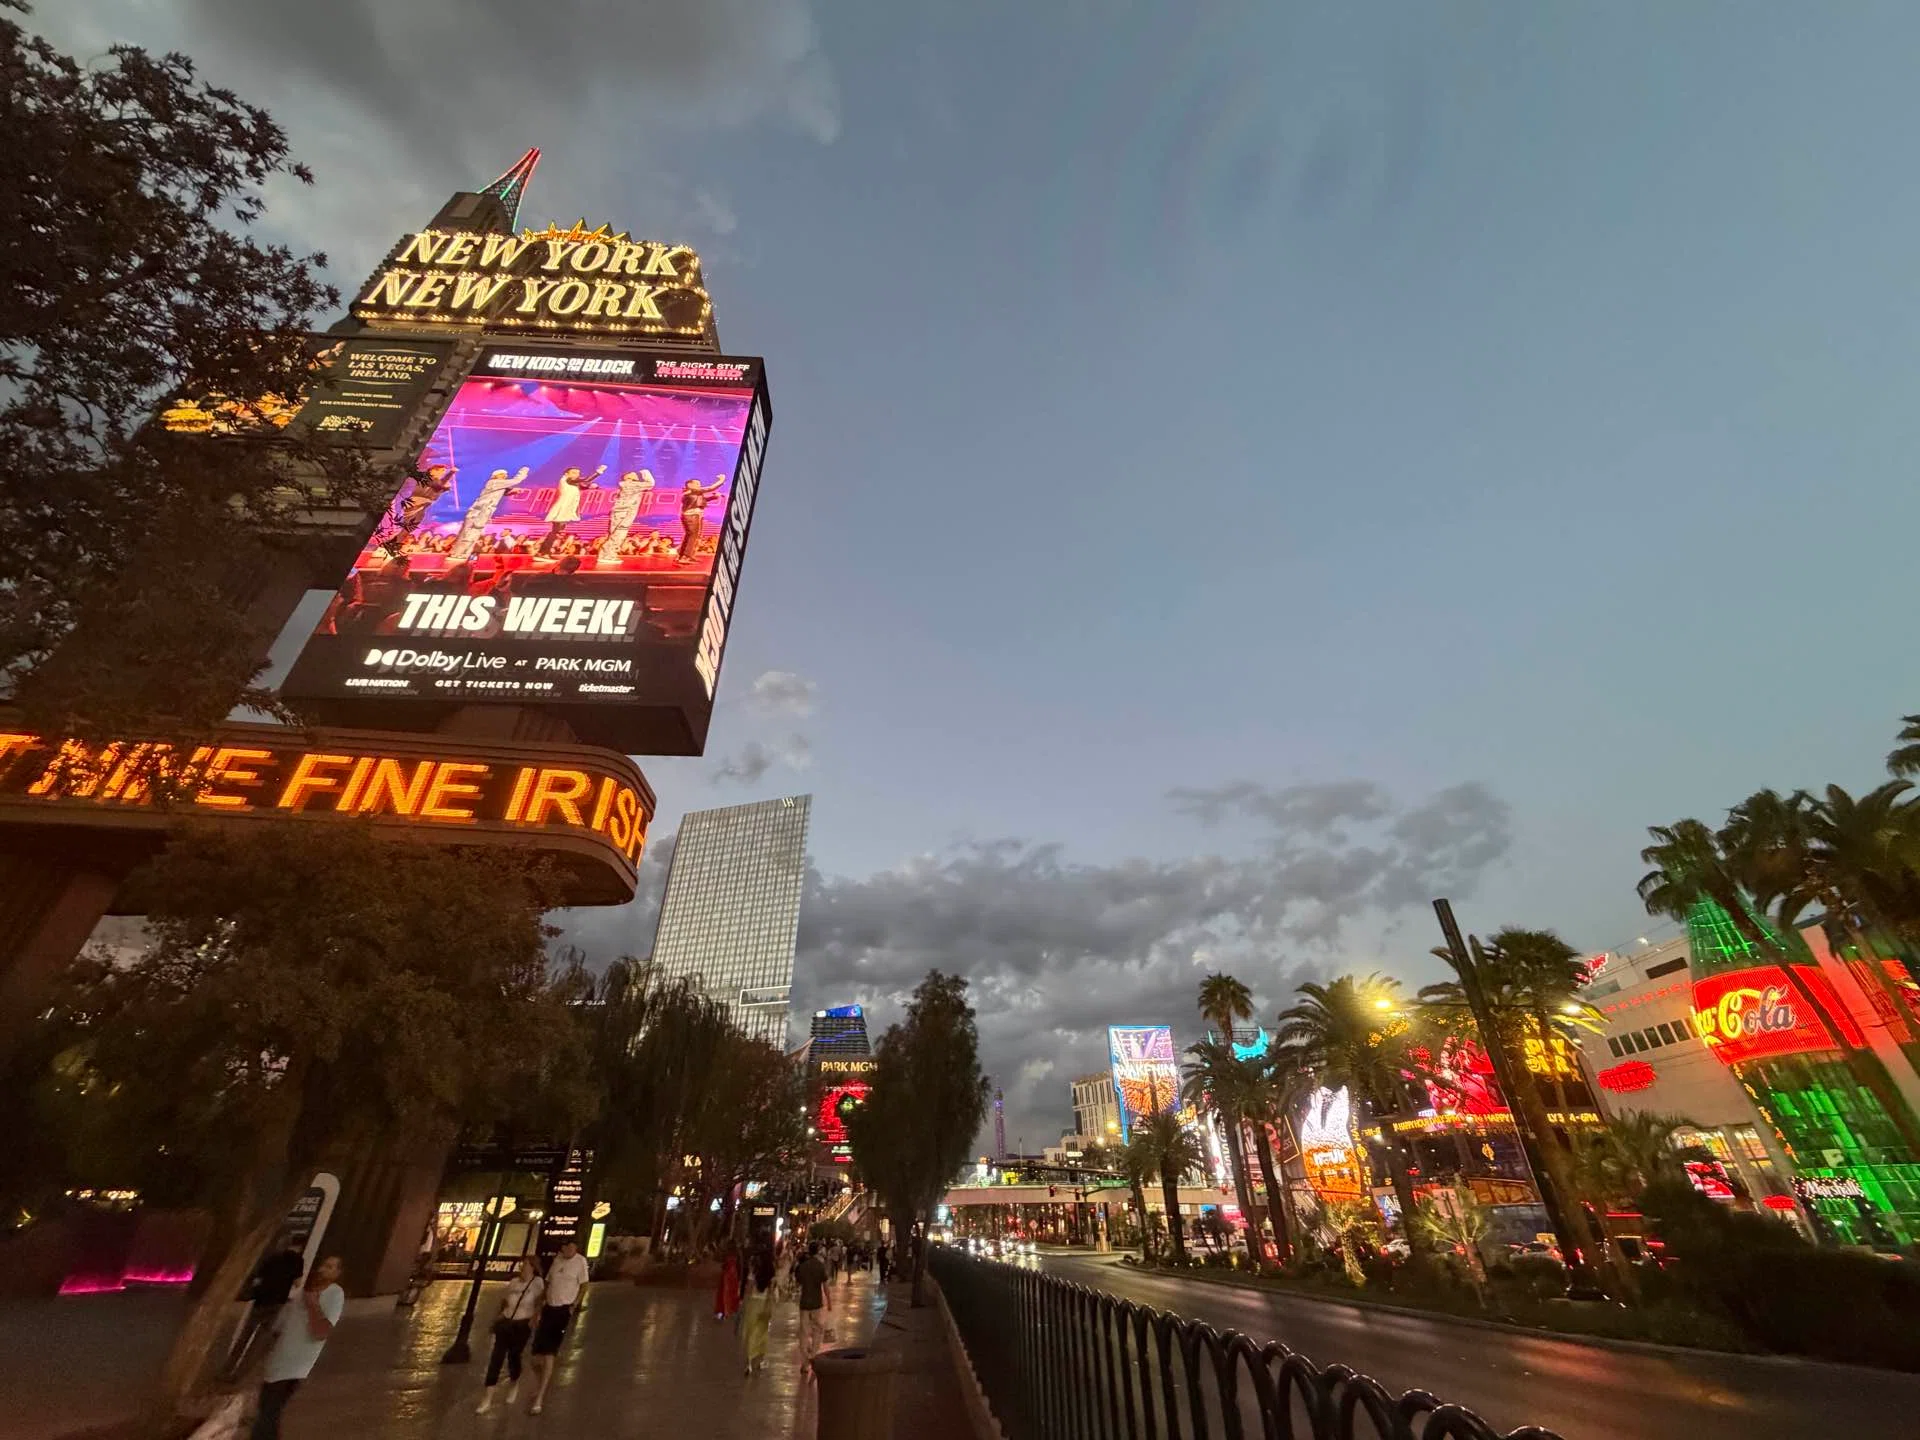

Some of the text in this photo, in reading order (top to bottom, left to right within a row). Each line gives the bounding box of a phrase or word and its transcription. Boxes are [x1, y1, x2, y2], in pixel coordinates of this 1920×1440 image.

[395, 233, 686, 277] NEW YORK
[361, 271, 672, 319] NEW YORK
[348, 361, 376, 369] LAS
[350, 353, 437, 365] WELCOME TO
[488, 354, 529, 369] NEW
[526, 356, 569, 371] KIDS
[582, 358, 636, 374] BLOCK
[656, 360, 750, 371] THE RIGHT STUFF
[350, 369, 412, 380] IRELAND.
[656, 366, 743, 377] REMIXED
[398, 593, 635, 635] THIS WEEK!
[695, 552, 732, 700] BLOCK
[396, 649, 631, 672] Dolby Live AT PARK MGM
[465, 680, 521, 689] TICKETS
[525, 682, 554, 690] NOW
[578, 683, 633, 694] ticketmaster
[278, 753, 490, 818] FINE
[821, 1061, 848, 1072] PARK
[1805, 1180, 1864, 1197] Marshalls
